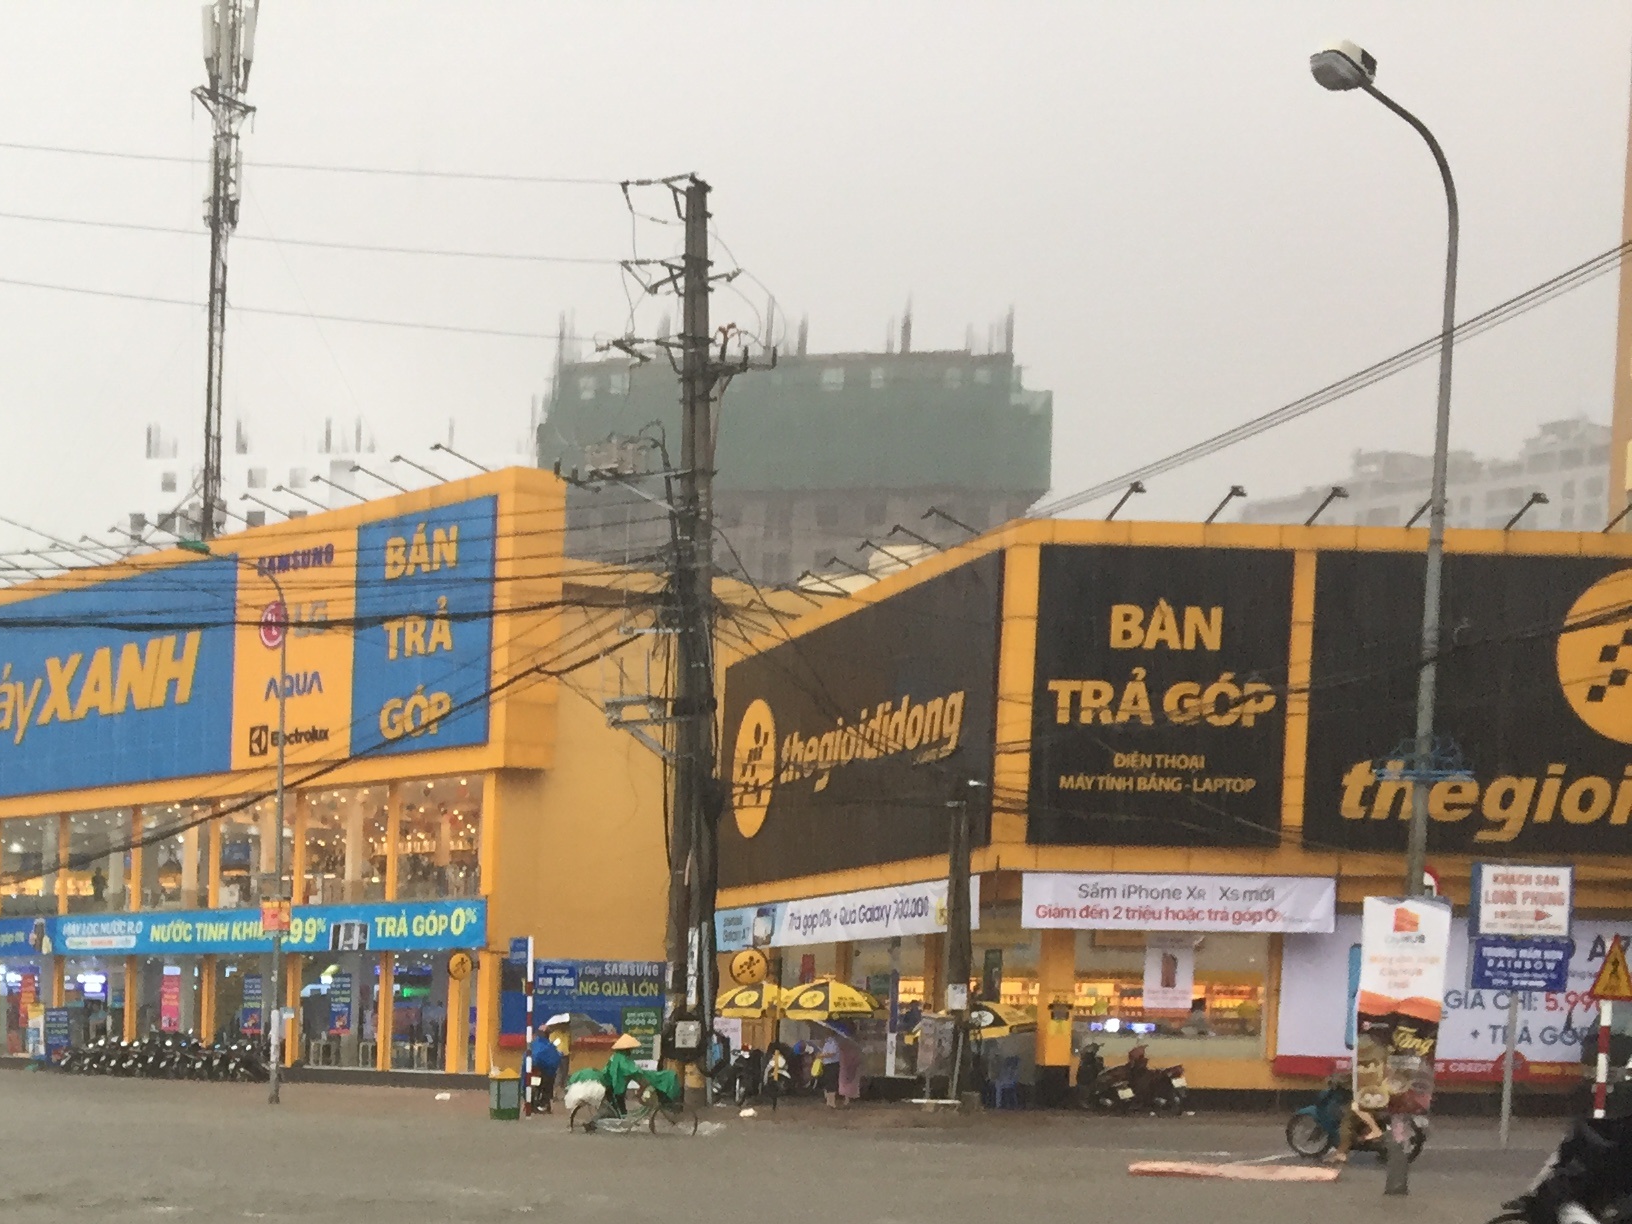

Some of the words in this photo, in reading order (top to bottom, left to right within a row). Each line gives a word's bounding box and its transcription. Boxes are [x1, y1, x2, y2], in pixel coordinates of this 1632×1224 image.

[384, 522, 459, 581] BÁN
[383, 595, 453, 661] TRẢ
[1110, 597, 1224, 651] BÁN
[36, 631, 201, 726] XANH
[1048, 666, 1154, 726] TRẢ
[1163, 671, 1277, 728] GÓP
[379, 684, 453, 741] GÓP
[780, 690, 965, 793] thegioididong
[1192, 777, 1257, 793] LAPTOP
[1078, 903, 1110, 920] đến
[1112, 905, 1123, 920] 2
[1122, 883, 1183, 901] iPhone
[150, 919, 193, 943] NƯỚC
[196, 921, 229, 942] TINH
[375, 909, 408, 938] TRẢ
[412, 909, 448, 937] GÓP
[450, 907, 479, 936] 0%
[601, 979, 630, 997] QUÀ
[633, 978, 659, 997] LỚN
[604, 963, 659, 977] SAMSUNG
